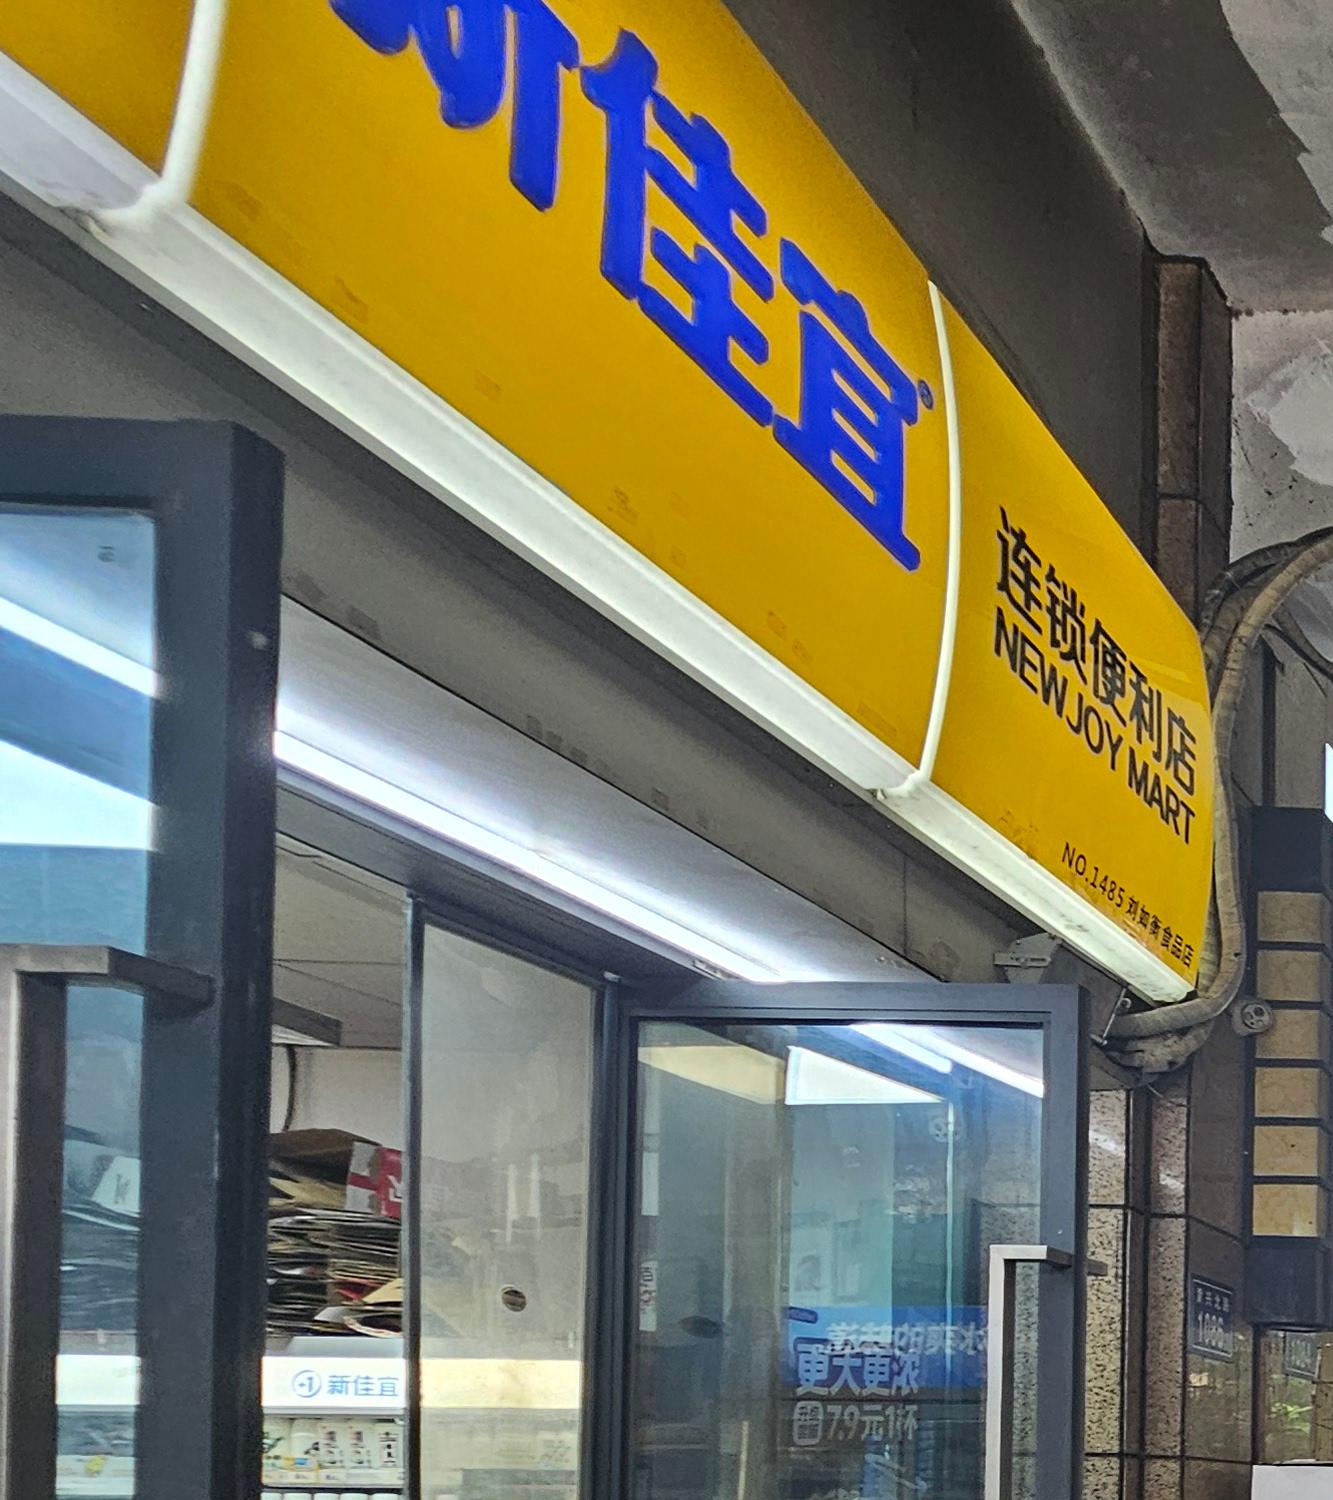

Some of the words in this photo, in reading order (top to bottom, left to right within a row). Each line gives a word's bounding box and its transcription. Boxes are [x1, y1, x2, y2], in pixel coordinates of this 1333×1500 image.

[994, 607, 1065, 720] NEW
[1066, 703, 1125, 771] JOY
[1127, 752, 1197, 845] MART
[996, 505, 1198, 797] 连锁便利店
[327, 1374, 399, 1398] 新佳宜
